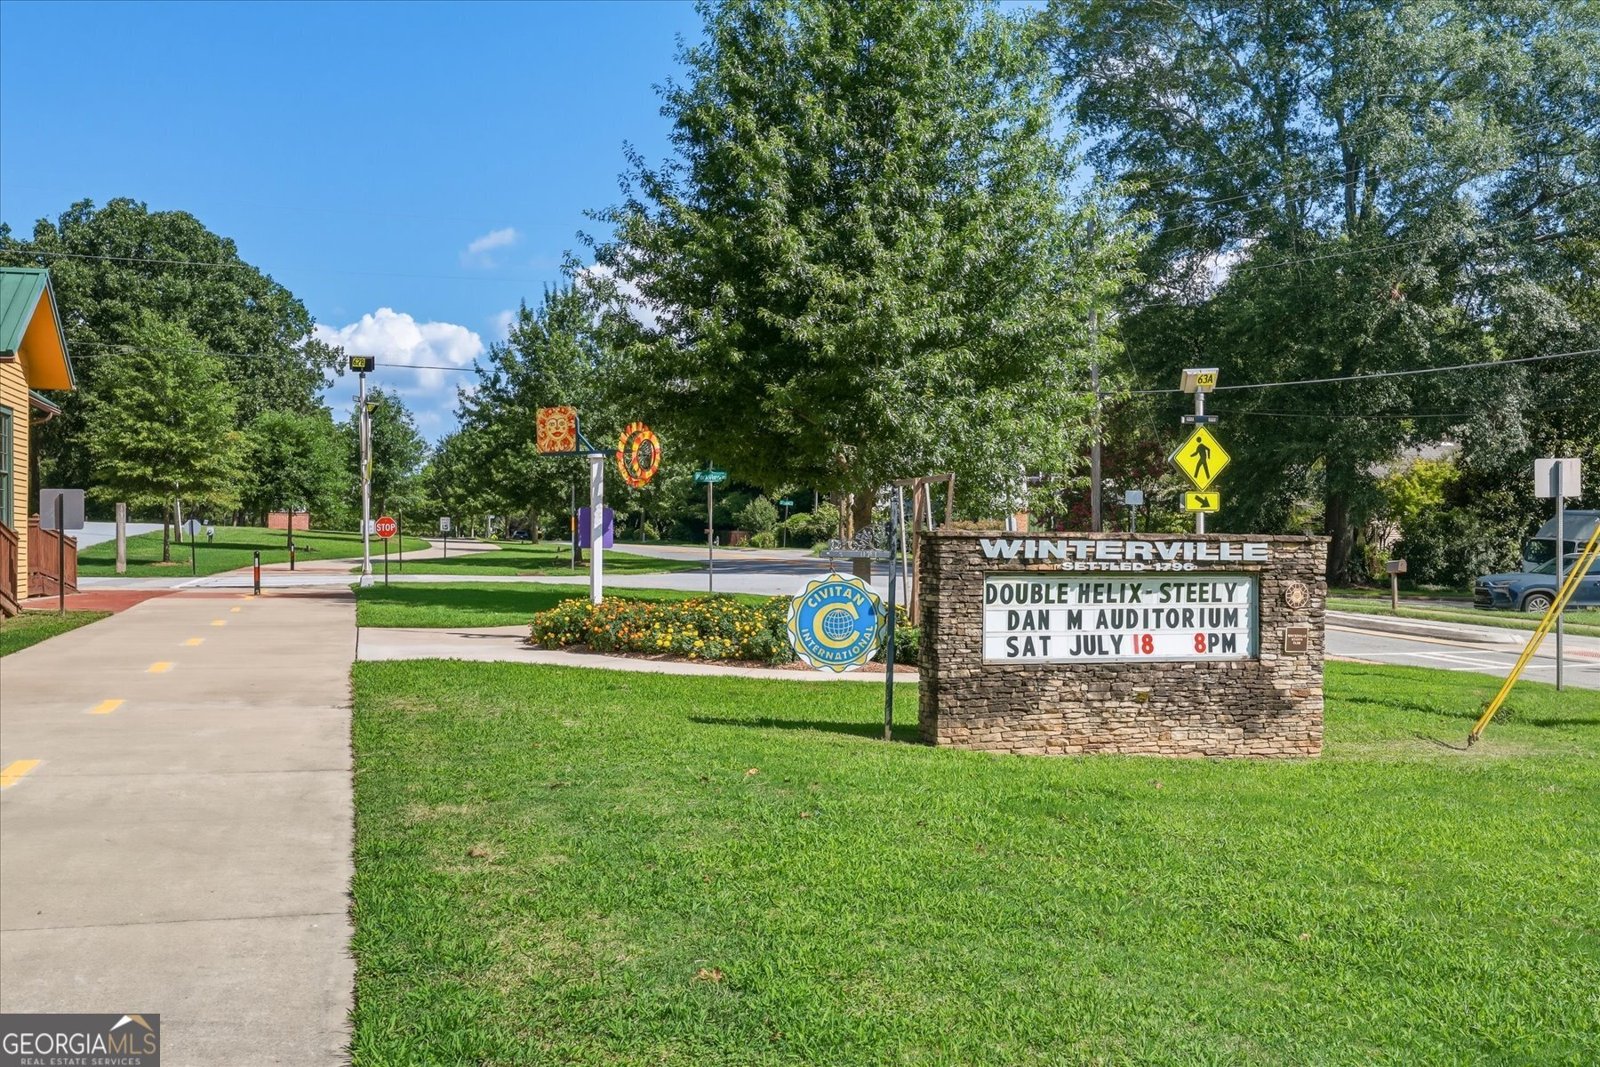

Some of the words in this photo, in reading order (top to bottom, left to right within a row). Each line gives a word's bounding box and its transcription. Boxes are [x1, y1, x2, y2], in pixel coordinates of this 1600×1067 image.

[1197, 374, 1213, 384] 63A
[376, 523, 396, 532] STOP
[979, 538, 1269, 561] WINTERVILLE
[1061, 561, 1145, 571] SETTLED
[1153, 562, 1195, 572] 1796
[807, 586, 865, 608] CIVITAN
[986, 582, 1069, 605] DOUBLE
[1159, 582, 1238, 604] STEELY
[1007, 609, 1050, 631] DAN
[1066, 609, 1083, 631] M
[1095, 607, 1239, 630] AUDITORIUM
[801, 625, 874, 661] INTERNATIONAL
[1006, 635, 1052, 658] SAT
[1069, 633, 1124, 656] JULY
[1132, 633, 1155, 655] 18
[1193, 632, 1238, 654] 8PM
